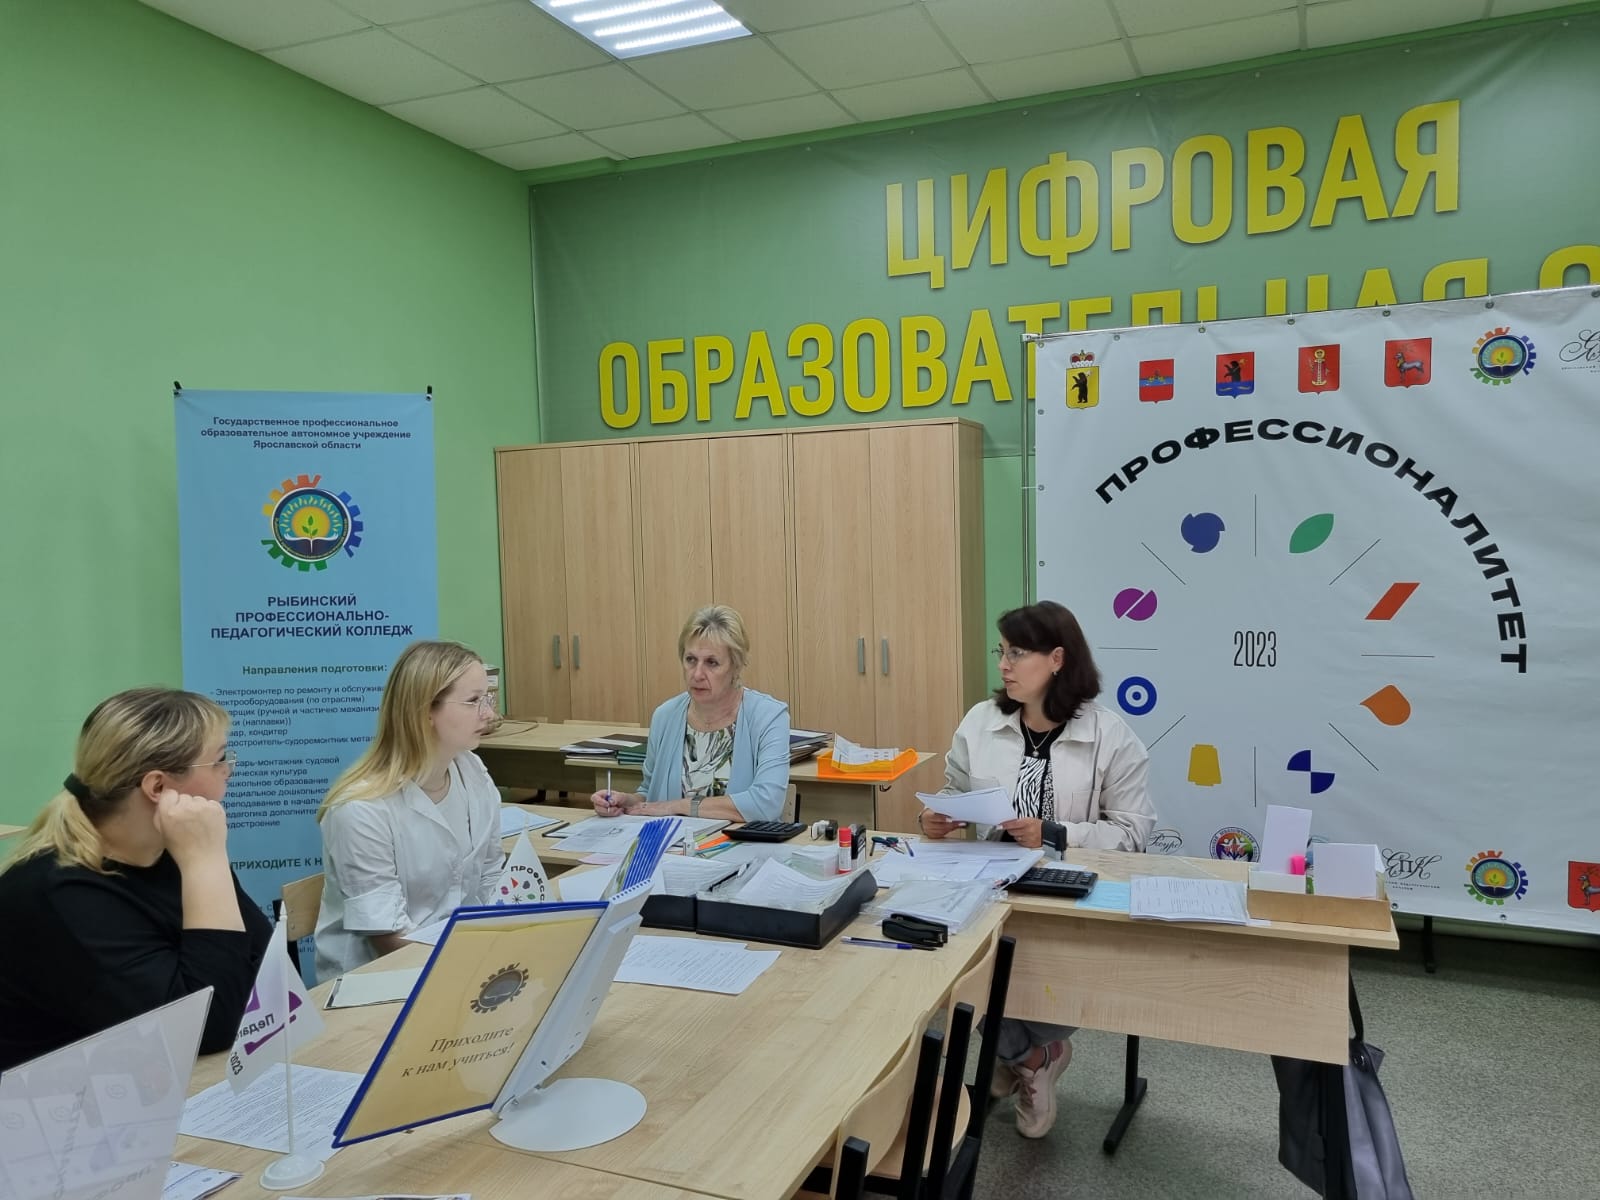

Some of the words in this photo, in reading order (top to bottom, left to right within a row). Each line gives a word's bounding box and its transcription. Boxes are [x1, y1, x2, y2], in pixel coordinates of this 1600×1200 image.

[886, 100, 1460, 289] ЦИФРОВАЯ
[598, 258, 1488, 429] ОБРАЗОВАТ
[213, 416, 300, 427] Государственное
[302, 418, 399, 428] профессиональное
[200, 428, 289, 438] образовательное
[291, 430, 351, 438] автономное
[353, 430, 411, 440] учреждение
[253, 440, 319, 450] Ярославской
[321, 441, 361, 449] области
[1095, 418, 1527, 674] ПРОФЕССИОНАЛИТЕТ
[267, 594, 357, 607] РЫБИНСКИЙ
[235, 610, 390, 624] ПРОФЕССИОНАЛЬНО-
[210, 624, 343, 640] ПЕДАГОГИЧЕСКИЙ
[346, 624, 413, 637] КОЛЛЕДЖ
[1233, 630, 1277, 668] 2023
[242, 664, 318, 676] Направления
[321, 663, 388, 674] подготовки:
[215, 688, 282, 697] Электромонтер
[297, 686, 332, 695] ремонту
[307, 696, 320, 705] (по
[321, 694, 365, 704] отраслям)
[258, 706, 290, 717] (ручной
[305, 756, 340, 766] судовой
[231, 858, 302, 871] ПРИХОДИТЕ
[304, 857, 312, 867] К
[430, 1027, 514, 1053] Приходите
[401, 1066, 414, 1078] к
[416, 1060, 448, 1075] нам
[448, 1041, 515, 1071] учиться!
